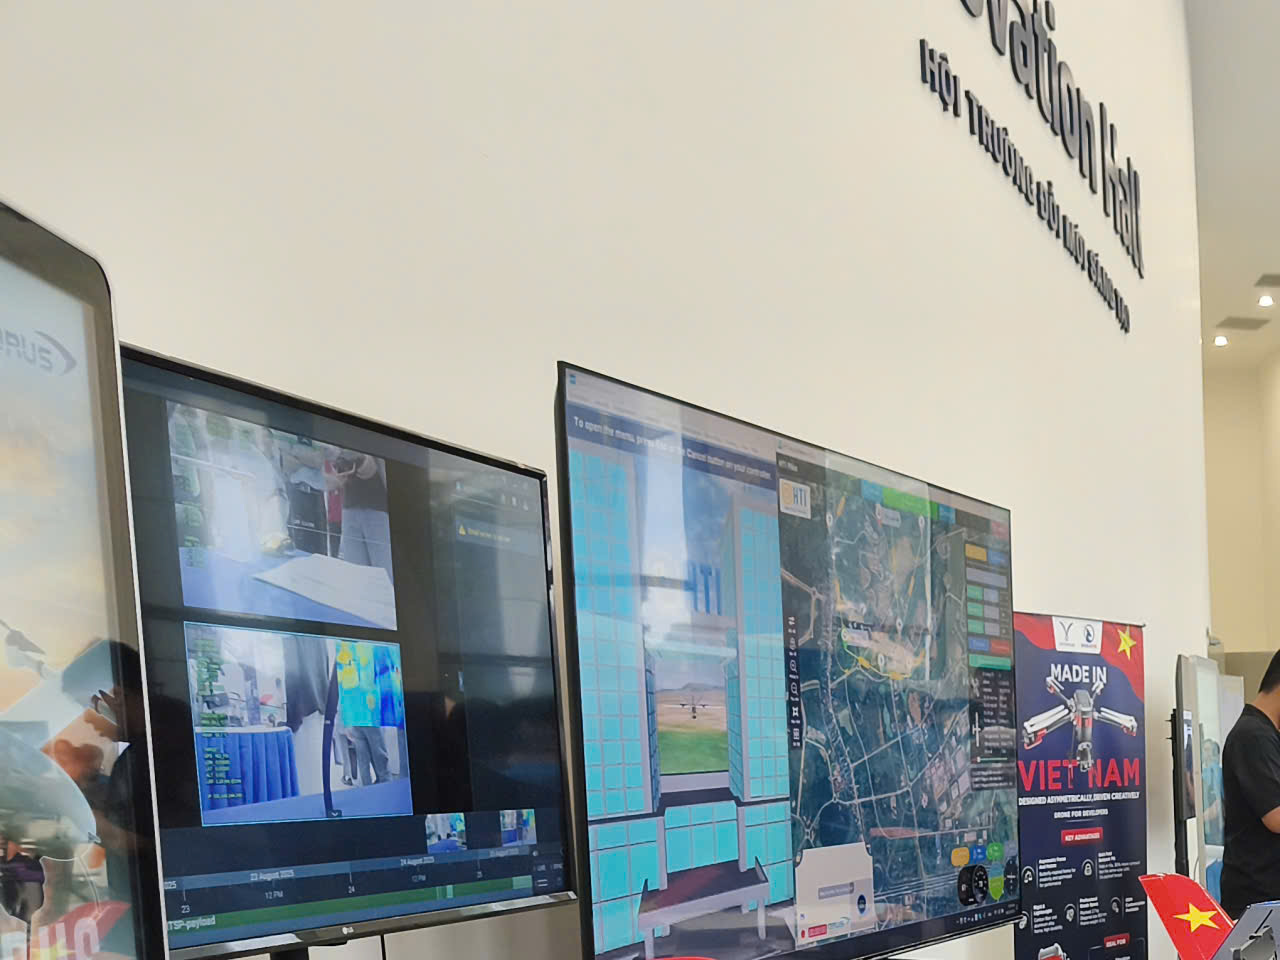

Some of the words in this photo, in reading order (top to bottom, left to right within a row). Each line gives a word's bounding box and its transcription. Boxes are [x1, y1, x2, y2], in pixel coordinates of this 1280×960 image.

[920, 38, 961, 117] HỘI
[960, 0, 1098, 195] vation
[1099, 102, 1145, 279] Hall
[1051, 663, 1091, 683] MADE
[1093, 666, 1107, 683] IN
[1018, 760, 1078, 791] VIET
[1087, 758, 1140, 788] NAM
